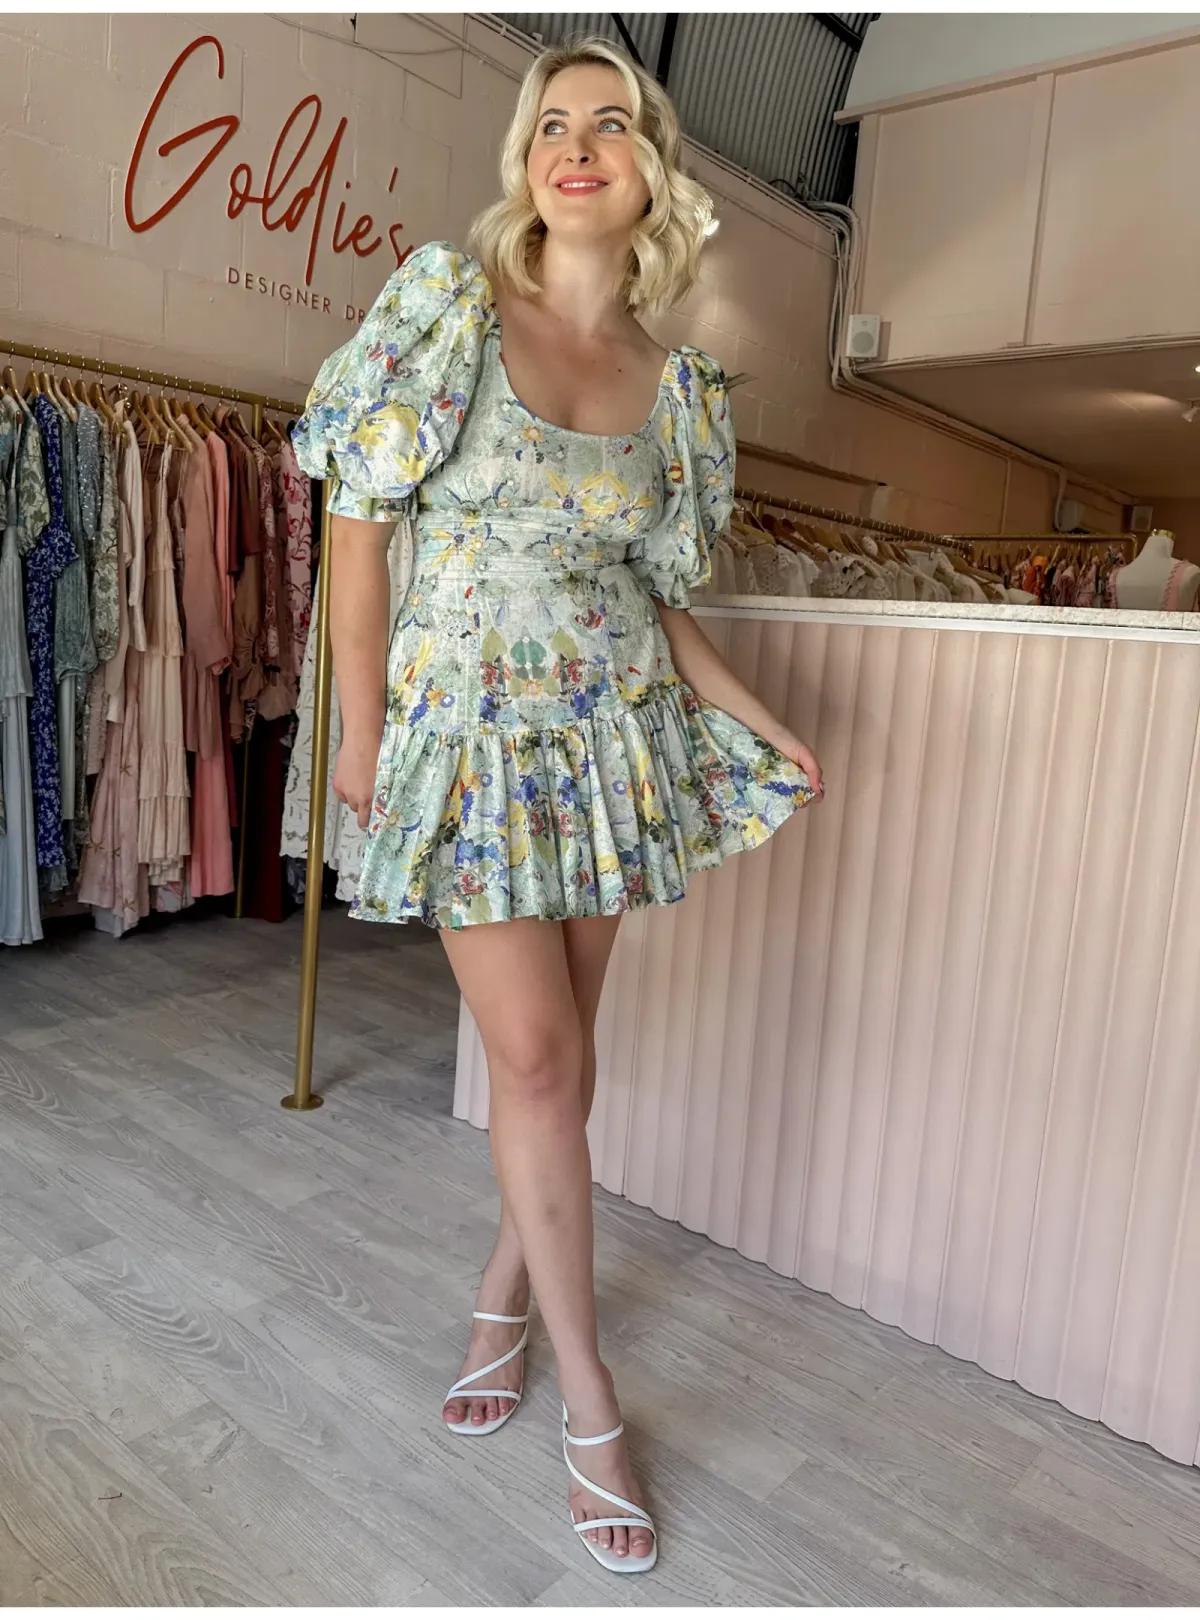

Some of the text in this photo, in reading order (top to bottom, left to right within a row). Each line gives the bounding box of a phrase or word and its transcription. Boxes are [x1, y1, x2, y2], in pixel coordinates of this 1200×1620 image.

[125, 35, 414, 286] Goldie's
[227, 267, 366, 324] DESIGNER DR
